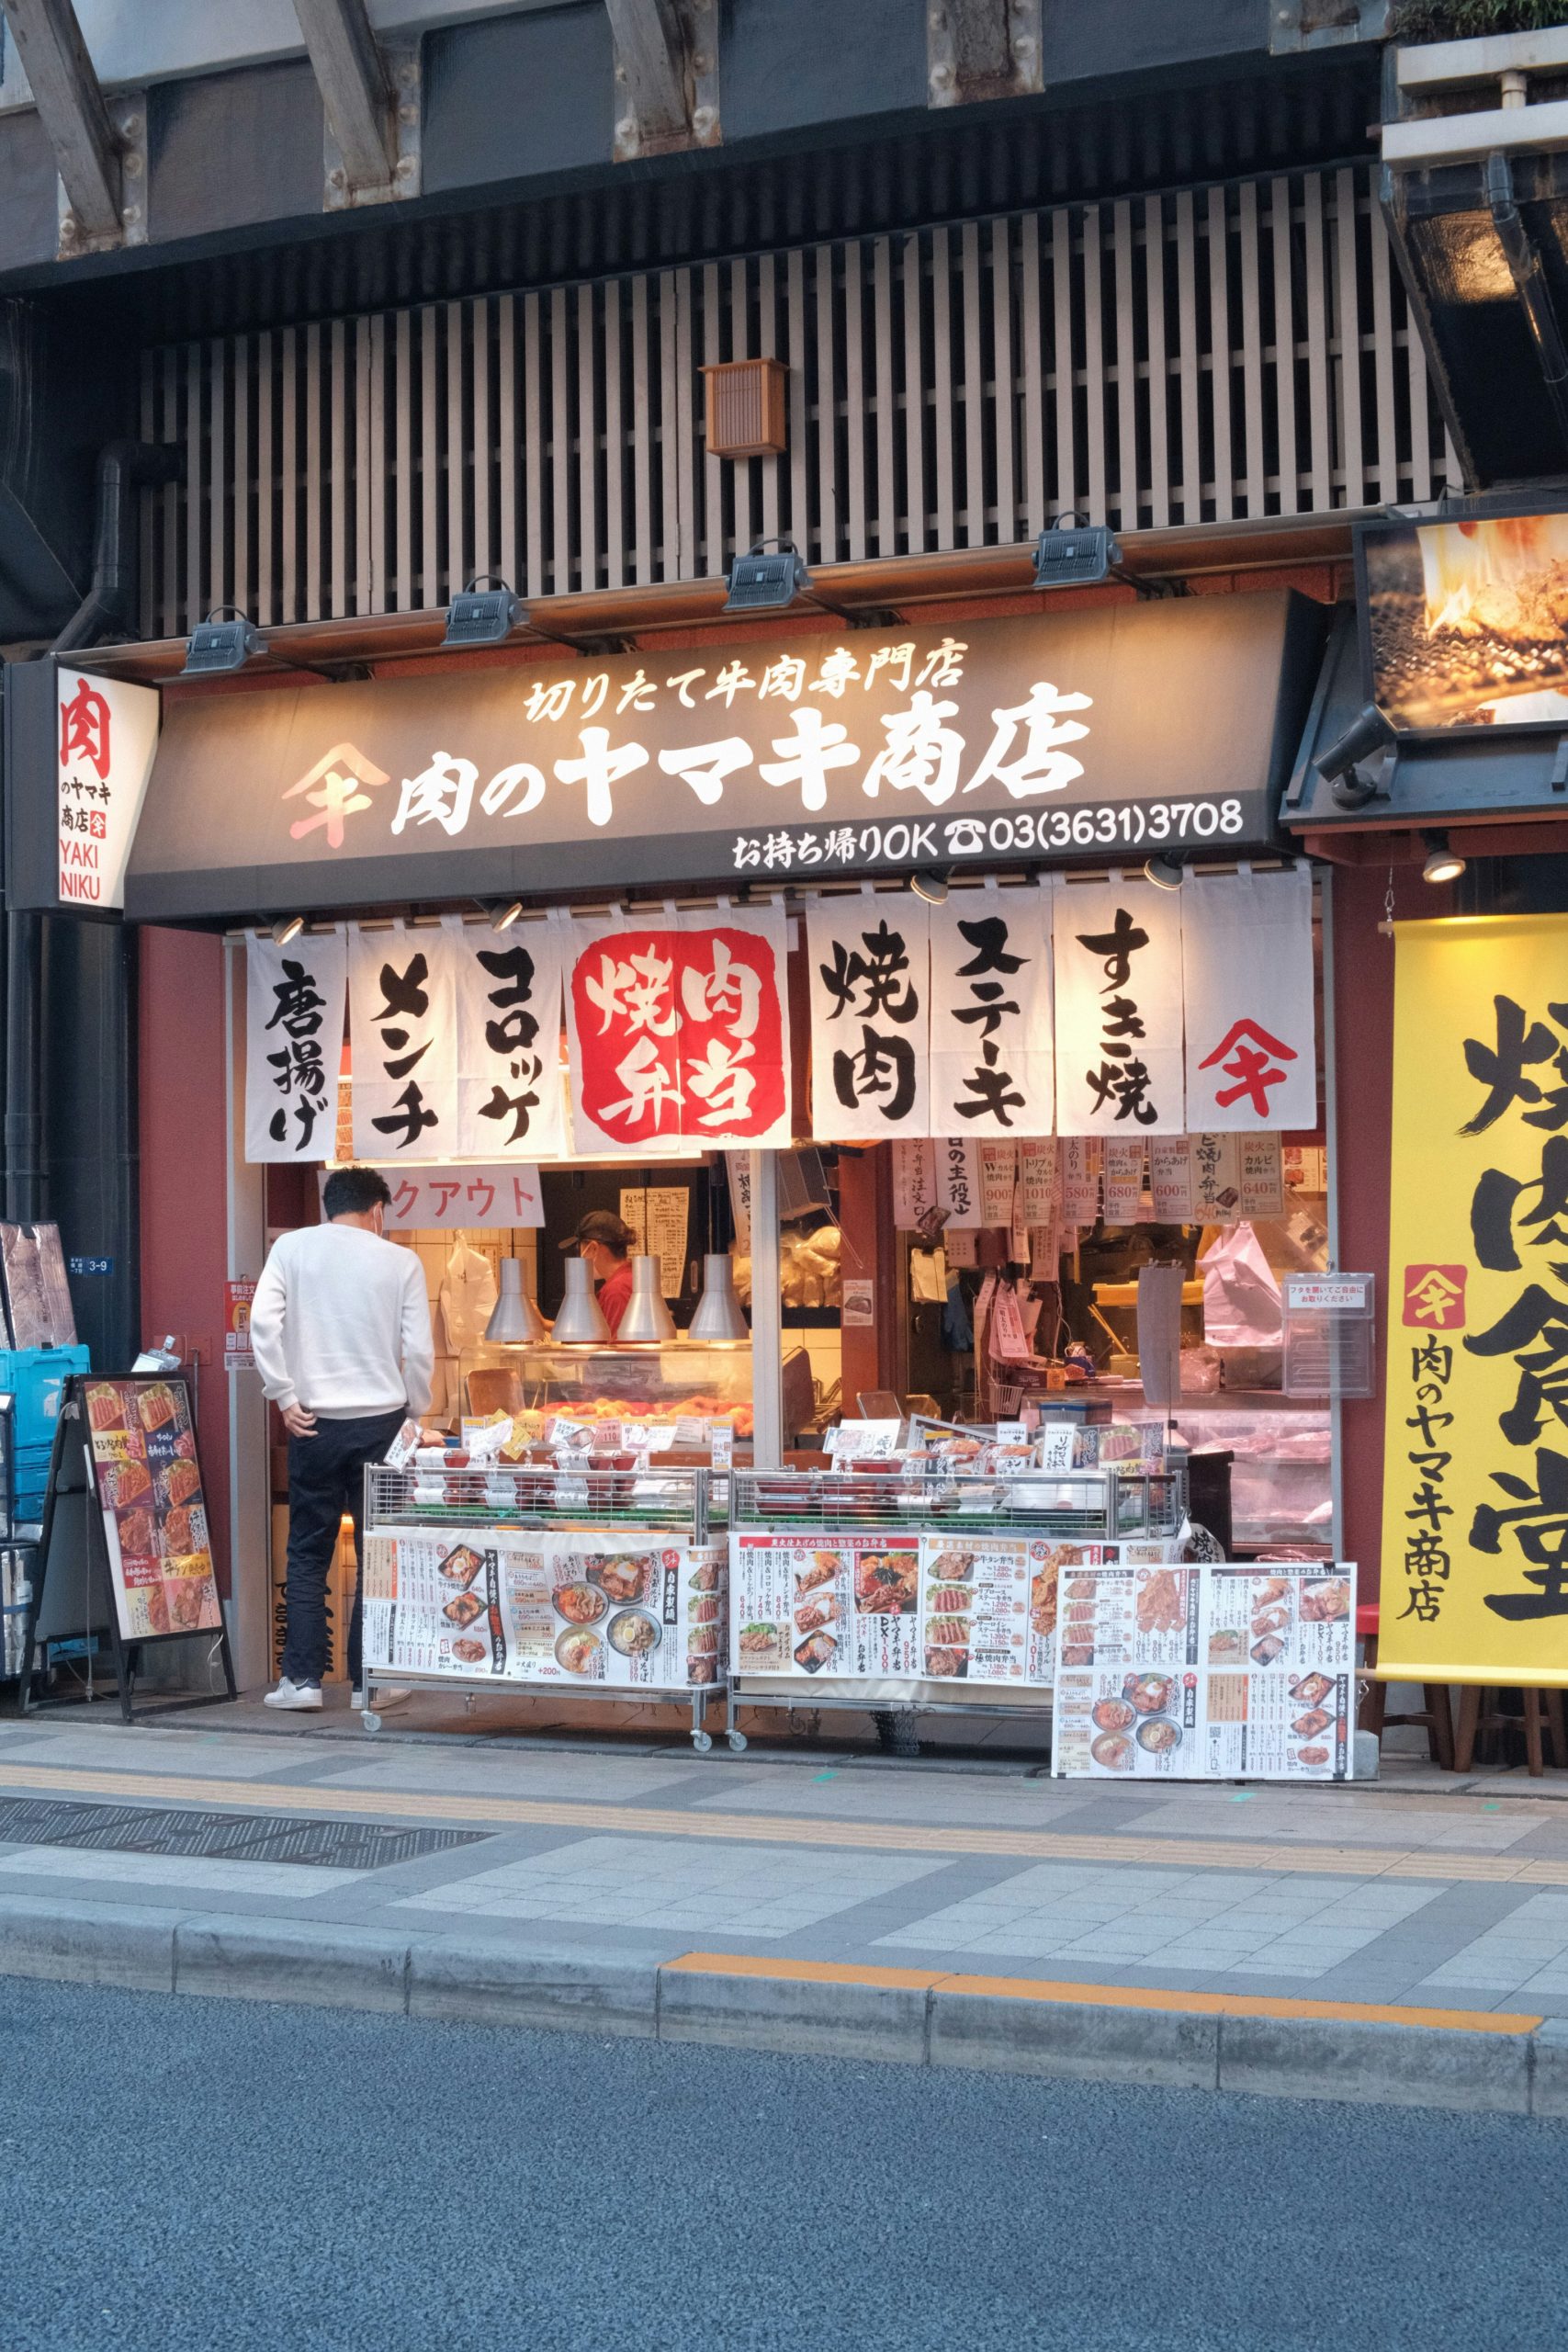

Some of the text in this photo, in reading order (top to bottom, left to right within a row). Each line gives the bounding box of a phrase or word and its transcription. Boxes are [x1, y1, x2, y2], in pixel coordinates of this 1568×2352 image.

[524, 638, 968, 723] 切りたて牛肉専門店
[59, 678, 110, 779] 肉
[390, 681, 1094, 836] 肉のヤマキ商店
[61, 776, 111, 806] のヤマキ
[61, 808, 89, 833] 商店
[60, 838, 98, 869] YAKI
[733, 798, 1245, 871] お持ち帰りOK 03(3631)3708
[60, 872, 101, 900] NIKU
[585, 937, 764, 1039] 焼肉
[818, 919, 920, 1121] 焼肉
[953, 916, 1032, 1128] ステーキ
[1076, 907, 1159, 1126] すき焼
[265, 958, 330, 1152] 唐揚げ
[370, 952, 440, 1149] メンチ
[475, 945, 543, 1147] コロッケ
[597, 1036, 757, 1129] 弁当
[392, 1177, 534, 1218] クアウト
[1068, 1140, 1078, 1170] 太のり
[1155, 1156, 1188, 1166] からあげ
[1196, 1134, 1222, 1204] ビ焼肉弁当
[1245, 1155, 1272, 1164] カルビ
[89, 1261, 107, 1272] 3-9
[1396, 1333, 1454, 1623] 肉のヤマキ商店
